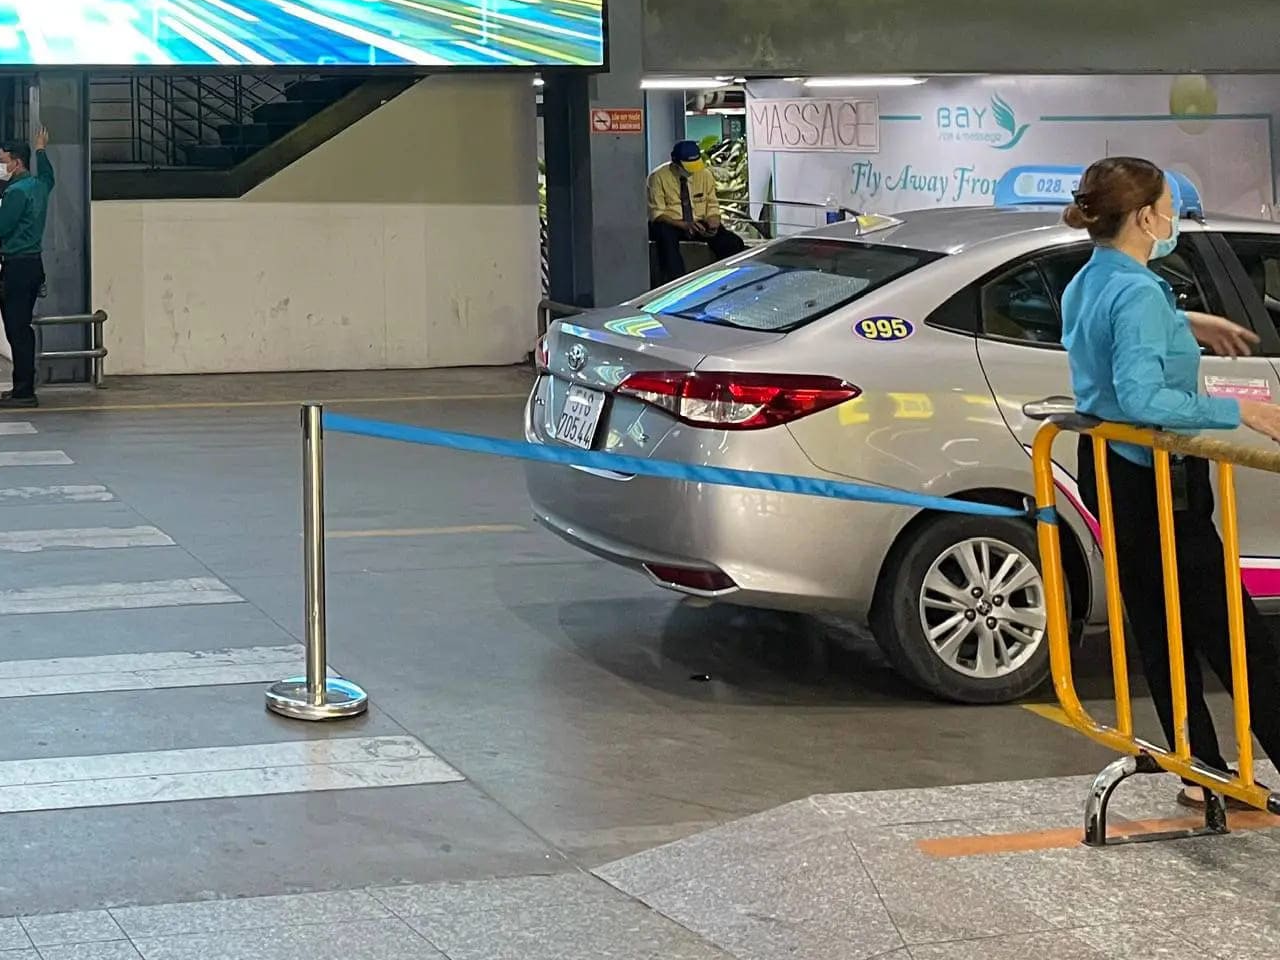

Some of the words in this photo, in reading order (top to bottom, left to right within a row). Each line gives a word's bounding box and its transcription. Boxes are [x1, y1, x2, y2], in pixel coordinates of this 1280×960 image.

[750, 102, 876, 148] MASSAGE
[850, 160, 882, 197] Fly
[885, 163, 949, 203] Away
[861, 319, 908, 339] 995
